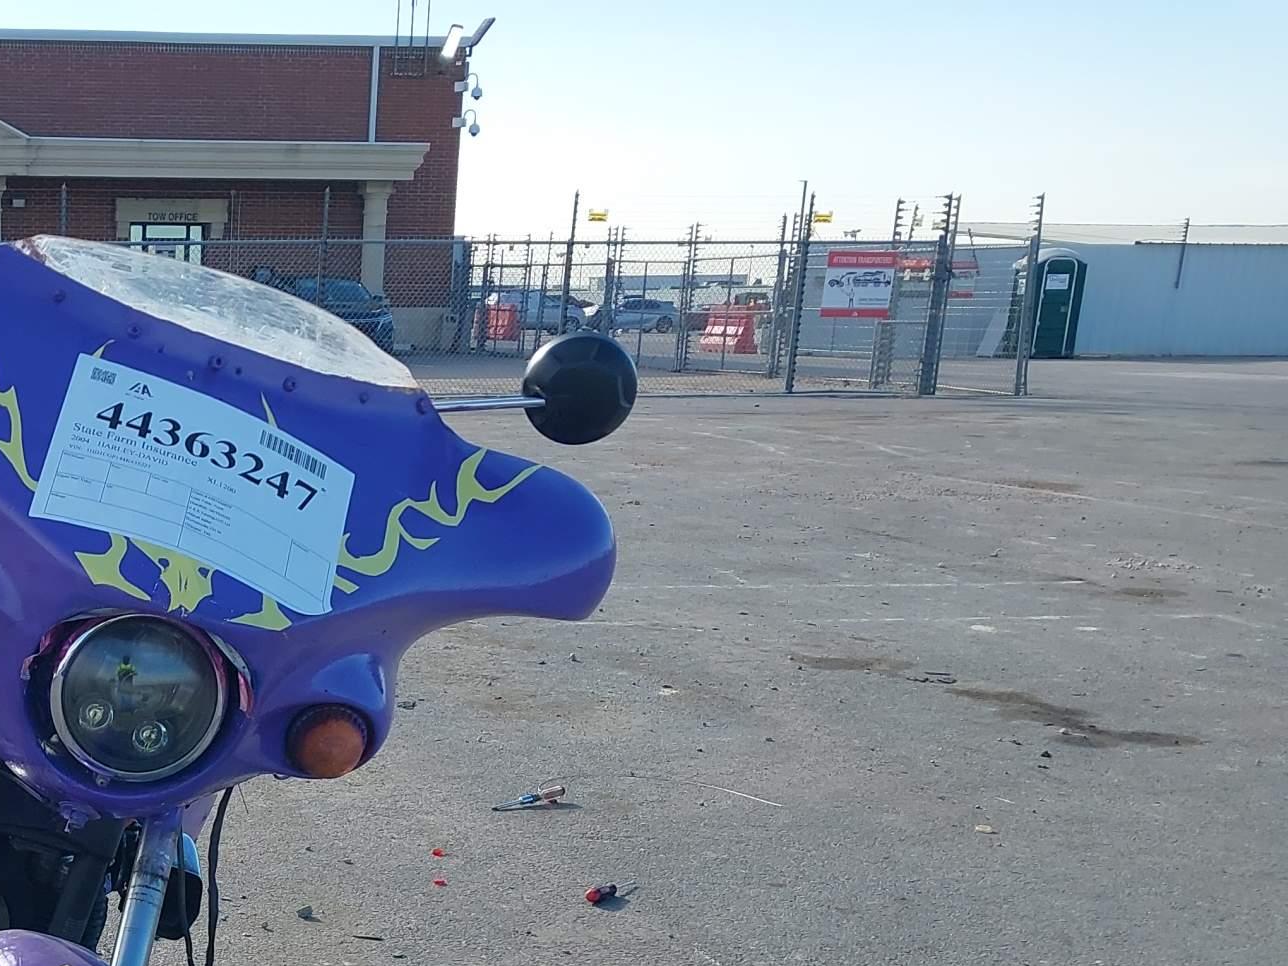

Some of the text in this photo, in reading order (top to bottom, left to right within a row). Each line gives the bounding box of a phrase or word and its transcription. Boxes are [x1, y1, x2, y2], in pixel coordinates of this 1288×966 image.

[147, 212, 199, 222] TOW OFFICE
[73, 422, 103, 437] State
[106, 430, 137, 446] Farm
[141, 440, 199, 467] Insurance
[96, 402, 319, 511] 44363247
[97, 440, 169, 466] HARLEY-DAVID
